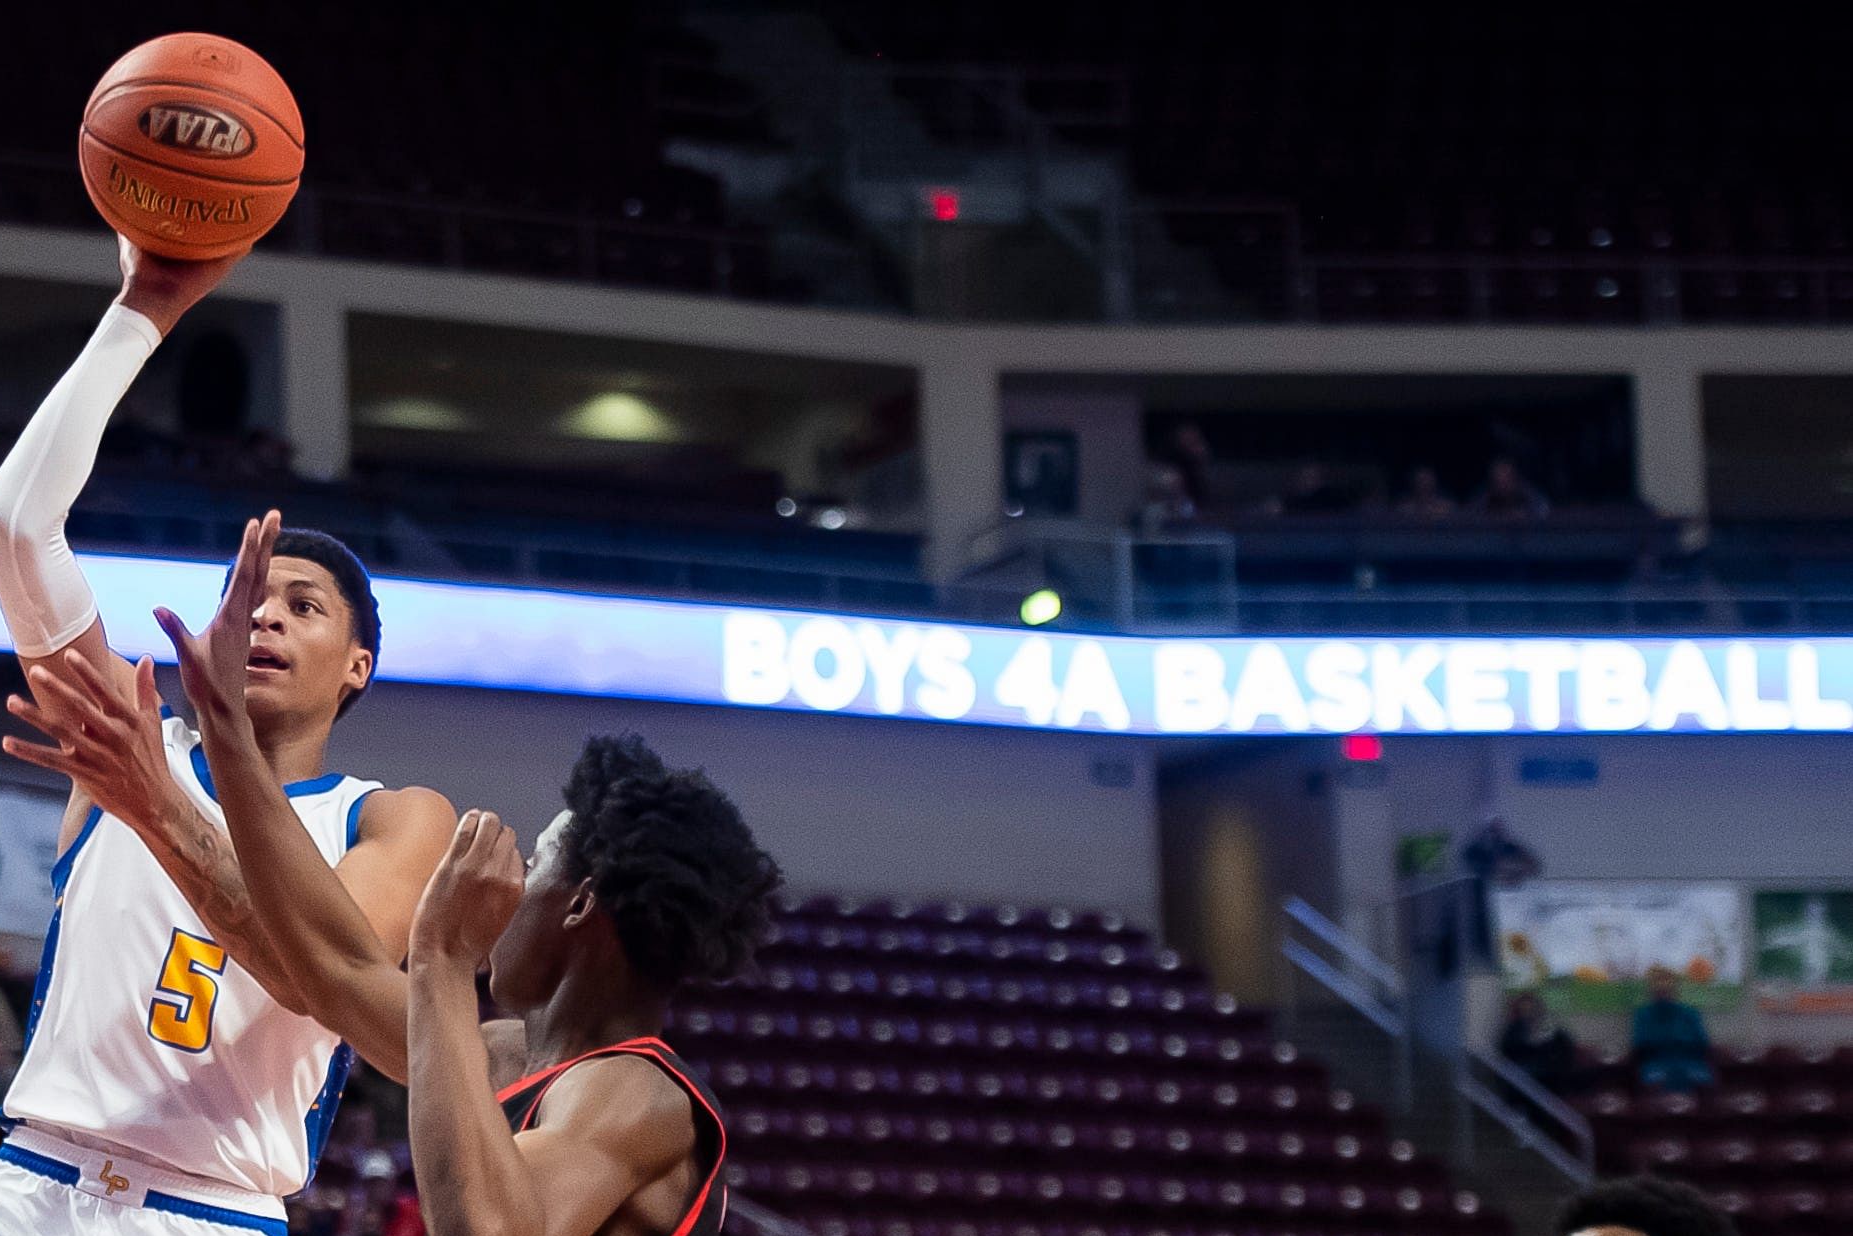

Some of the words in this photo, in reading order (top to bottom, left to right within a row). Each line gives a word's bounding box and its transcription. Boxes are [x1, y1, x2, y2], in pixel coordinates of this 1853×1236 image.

[149, 106, 242, 155] PIAA
[110, 162, 255, 224] SPALDING
[723, 610, 977, 721] BOYS
[996, 634, 1131, 730] 4A
[1152, 640, 1851, 732] BASKETBALL
[147, 926, 228, 1054] 5
